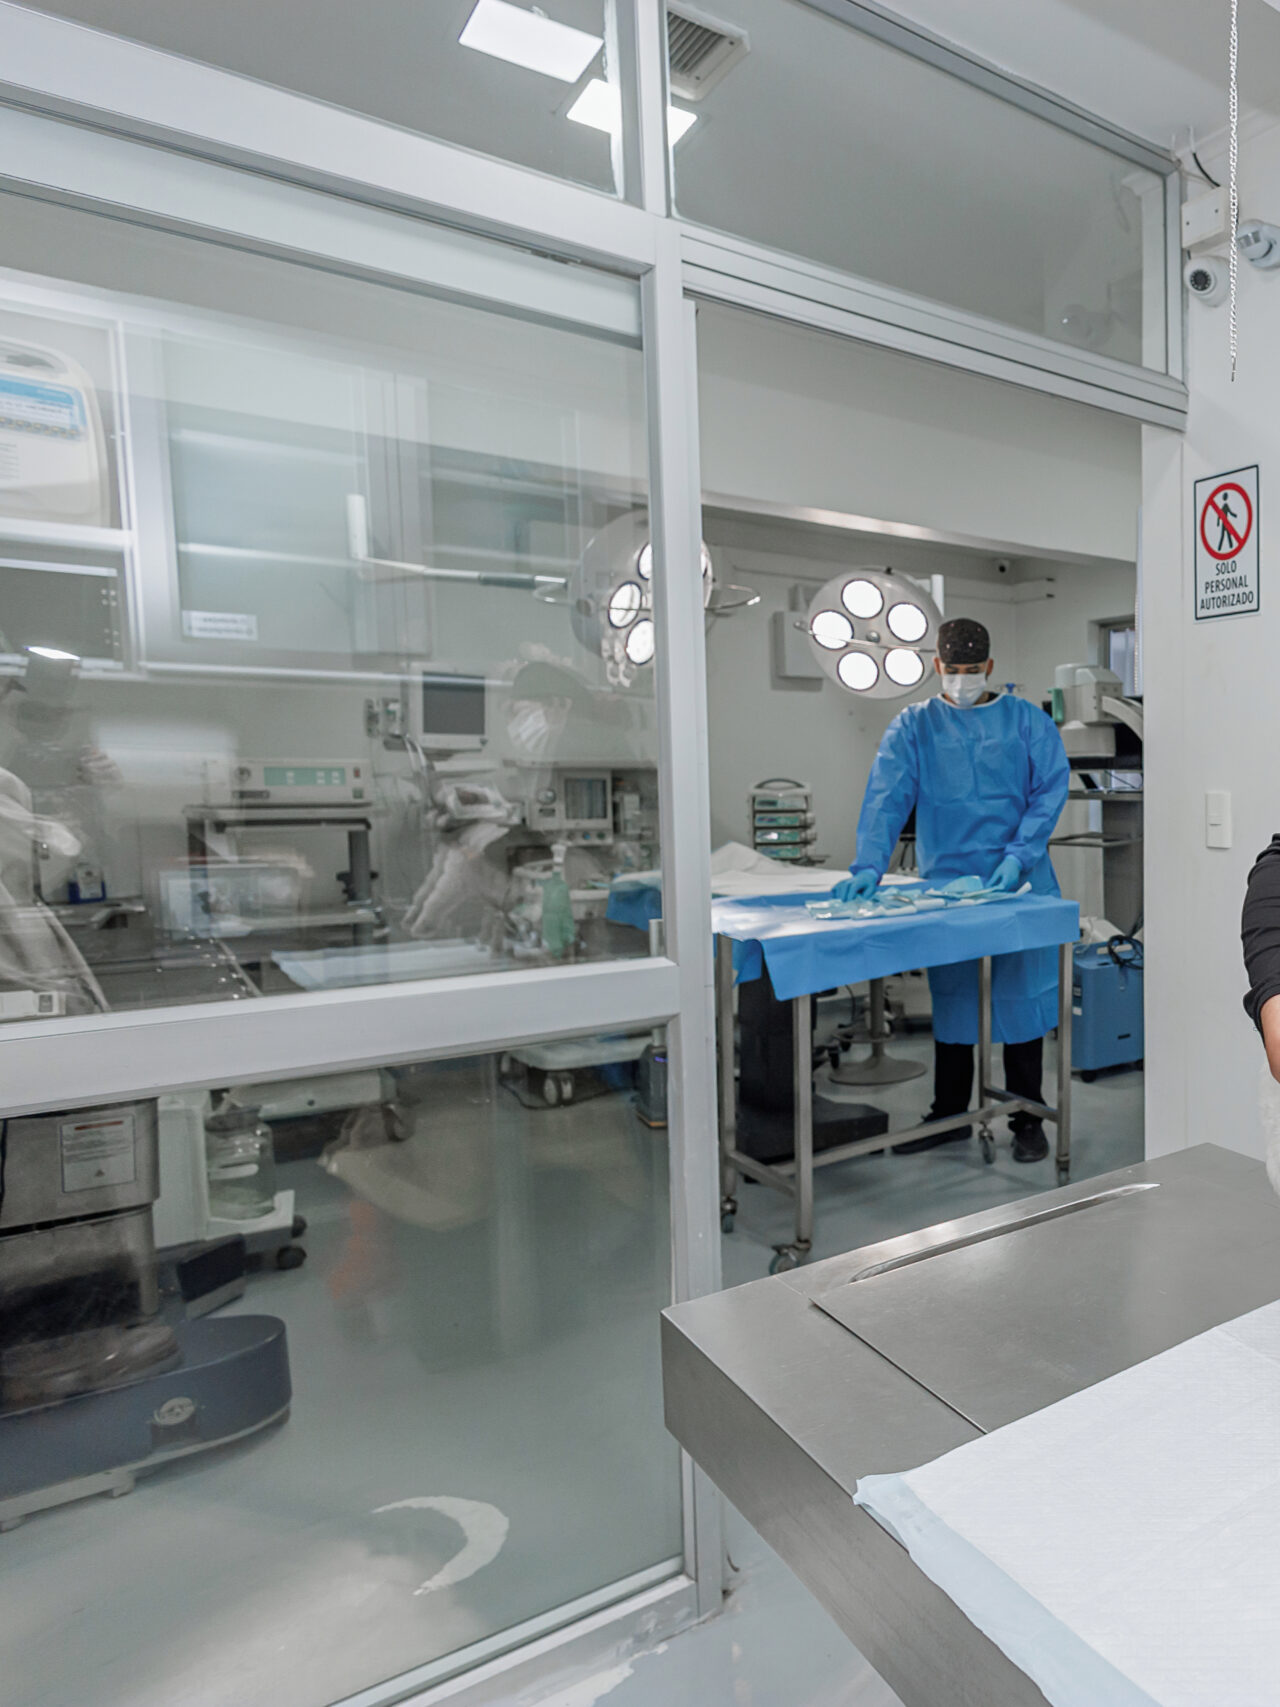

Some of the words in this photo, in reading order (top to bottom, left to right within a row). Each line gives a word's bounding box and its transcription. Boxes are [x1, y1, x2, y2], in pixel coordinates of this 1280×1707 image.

[1216, 560, 1237, 576] SOLO
[1205, 575, 1248, 594] PERSONAL
[1201, 591, 1254, 610] AUTORIZADO
